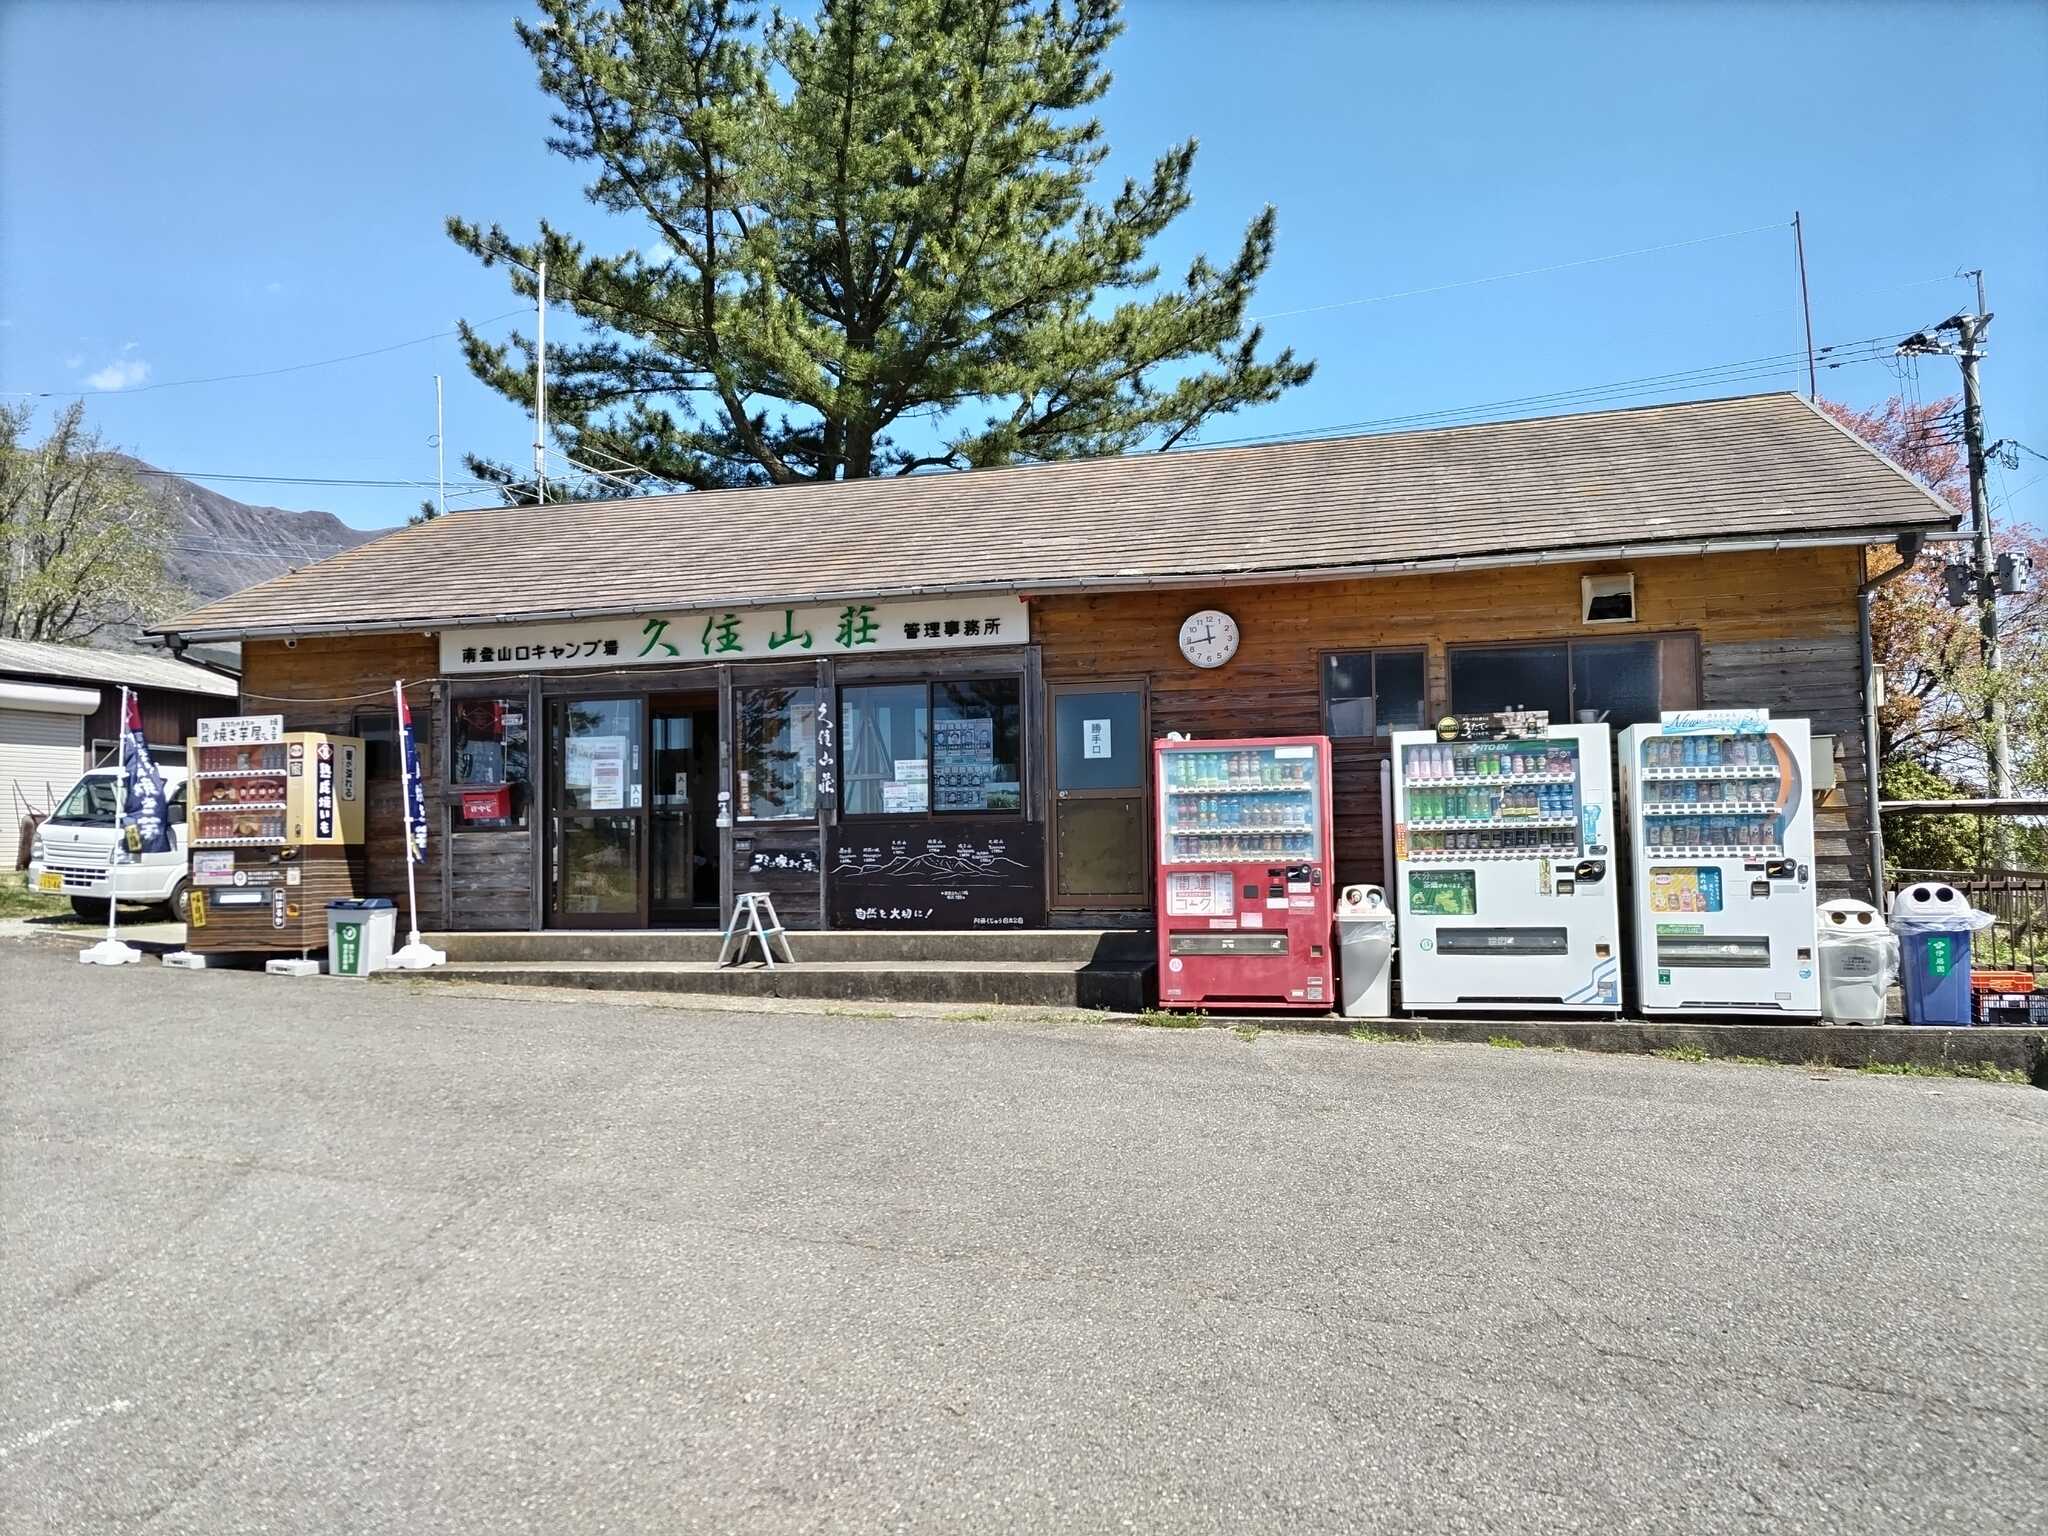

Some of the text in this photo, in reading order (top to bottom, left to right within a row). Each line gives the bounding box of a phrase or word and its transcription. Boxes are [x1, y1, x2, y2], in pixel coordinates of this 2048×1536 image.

[462, 604, 1001, 664] 南登山口キャンプ場 久住山荘 管理事務所
[1091, 722, 1102, 755] 勝手口
[632, 786, 640, 805] 入口
